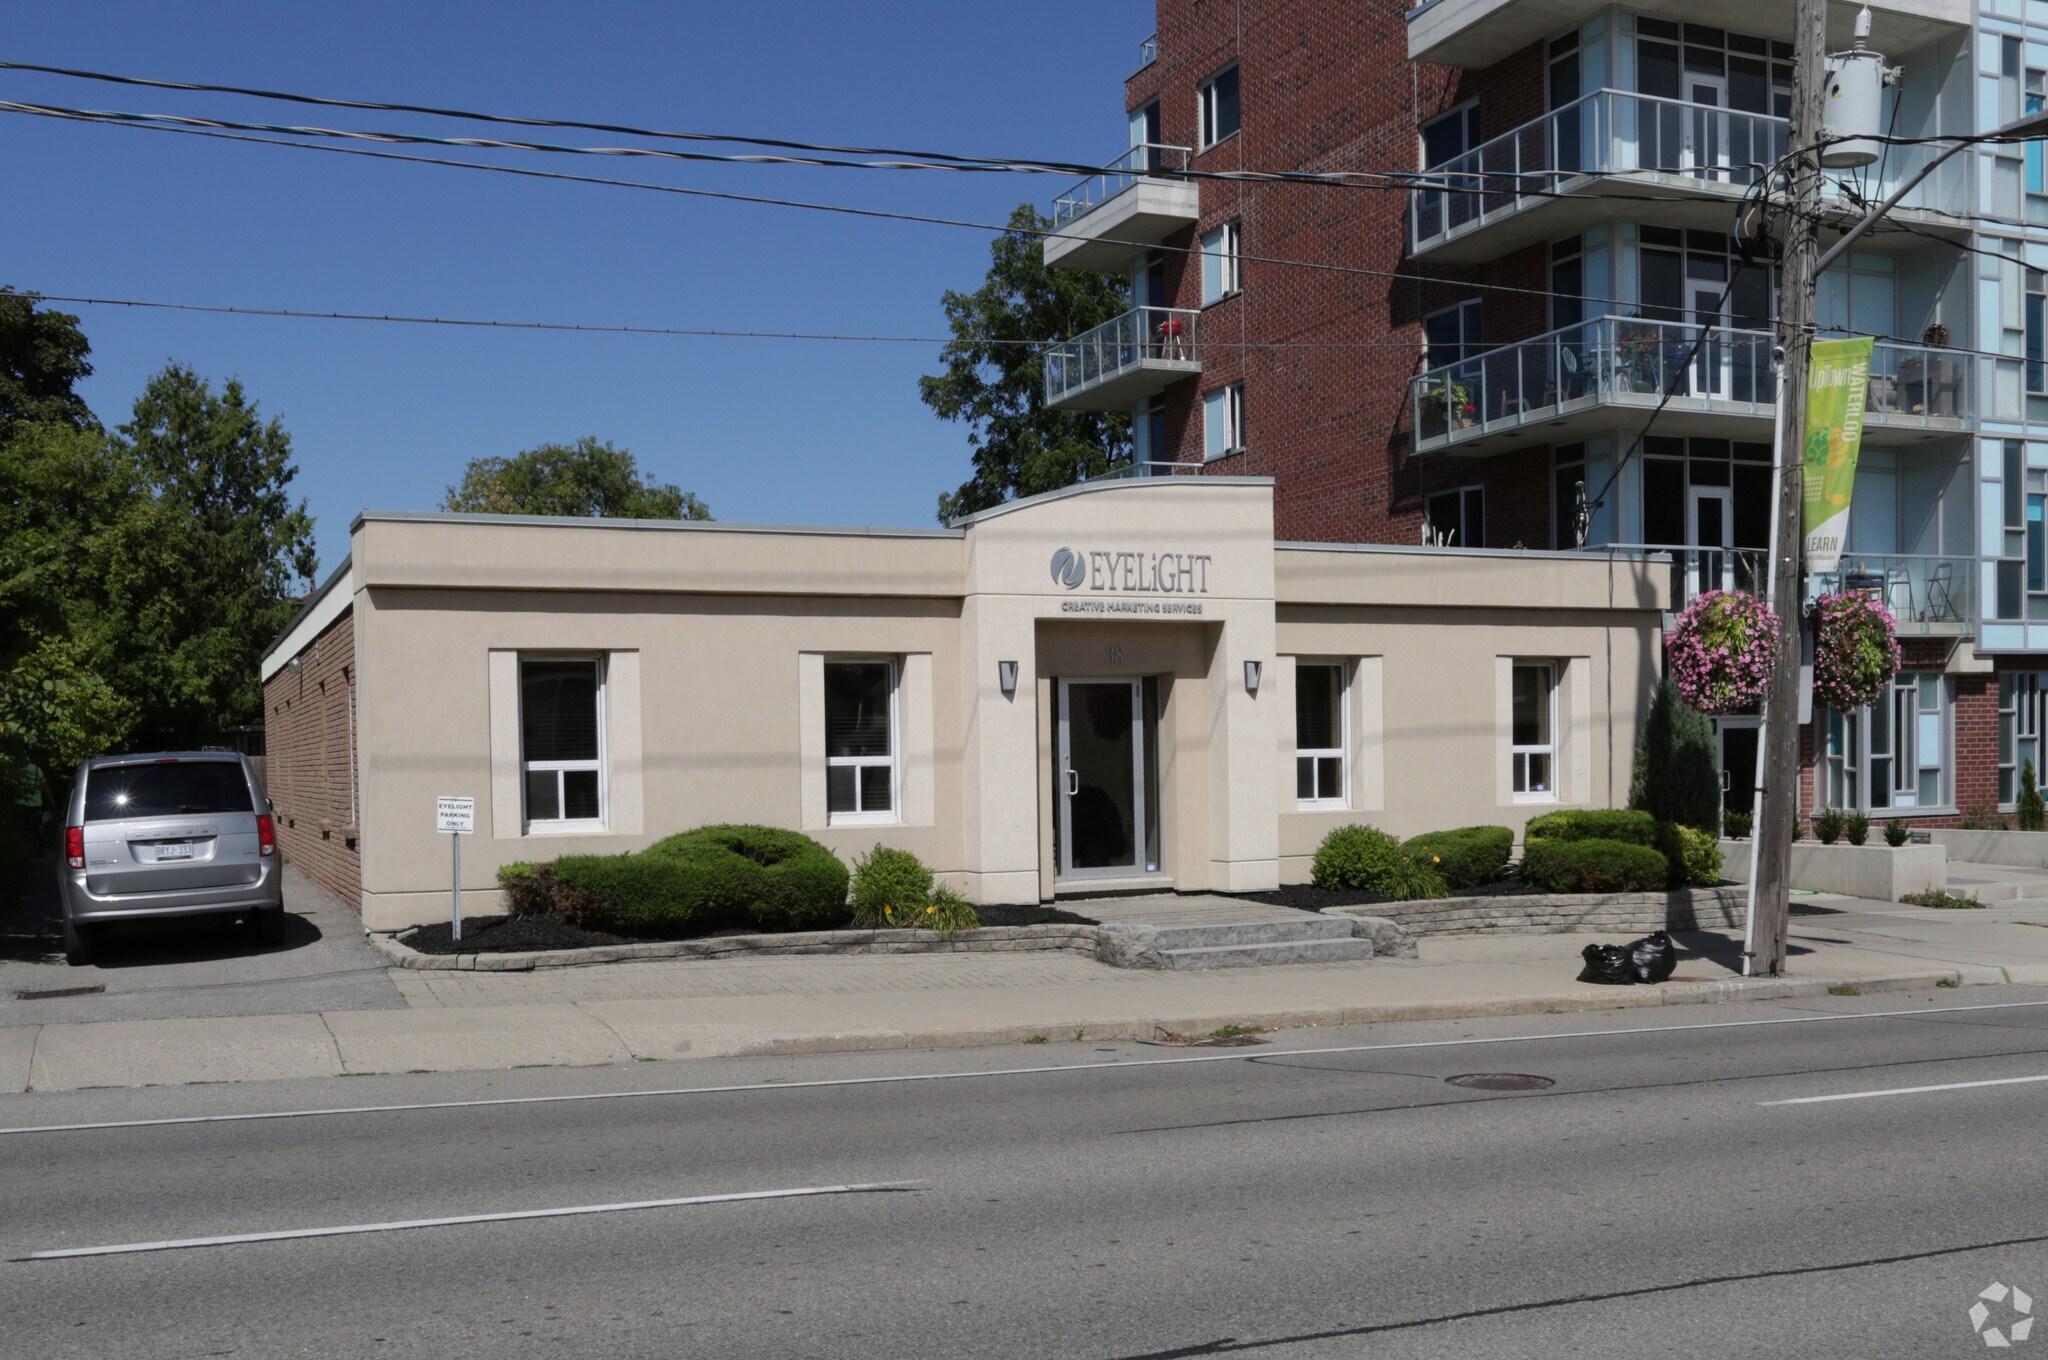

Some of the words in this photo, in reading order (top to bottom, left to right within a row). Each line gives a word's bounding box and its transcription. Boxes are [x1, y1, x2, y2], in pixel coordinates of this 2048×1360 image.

[1841, 362, 1868, 442] WATERLOO
[1807, 537, 1839, 552] LEARN
[1061, 601, 1105, 613] CREATIVE
[1106, 602, 1160, 614] MARKETING
[1162, 603, 1203, 615] SERVICES
[1104, 646, 1124, 665] 38
